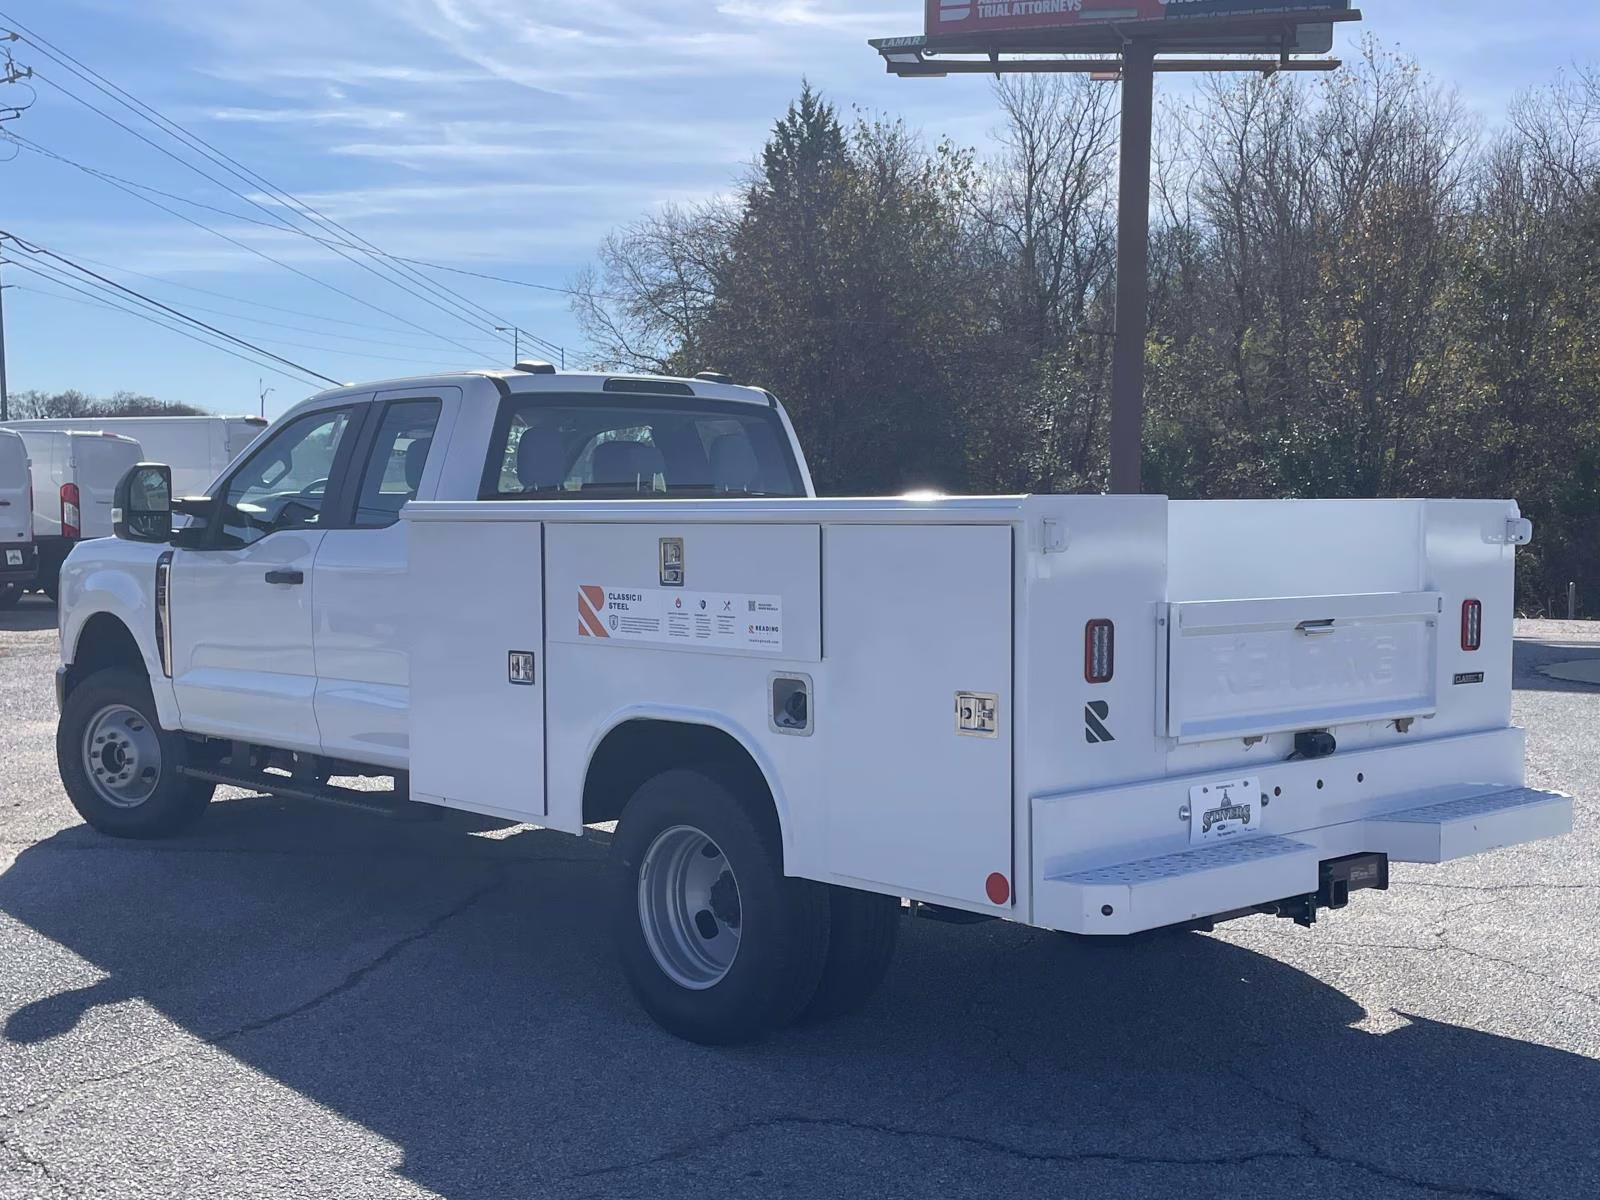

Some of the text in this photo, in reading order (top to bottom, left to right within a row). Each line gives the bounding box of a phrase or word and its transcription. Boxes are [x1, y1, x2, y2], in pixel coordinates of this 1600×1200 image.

[978, 0, 1082, 18] TRIAL ATTORNEYS
[881, 36, 921, 47] LAMAR
[609, 593, 636, 601] CLASSIC
[608, 602, 629, 610] STEEL
